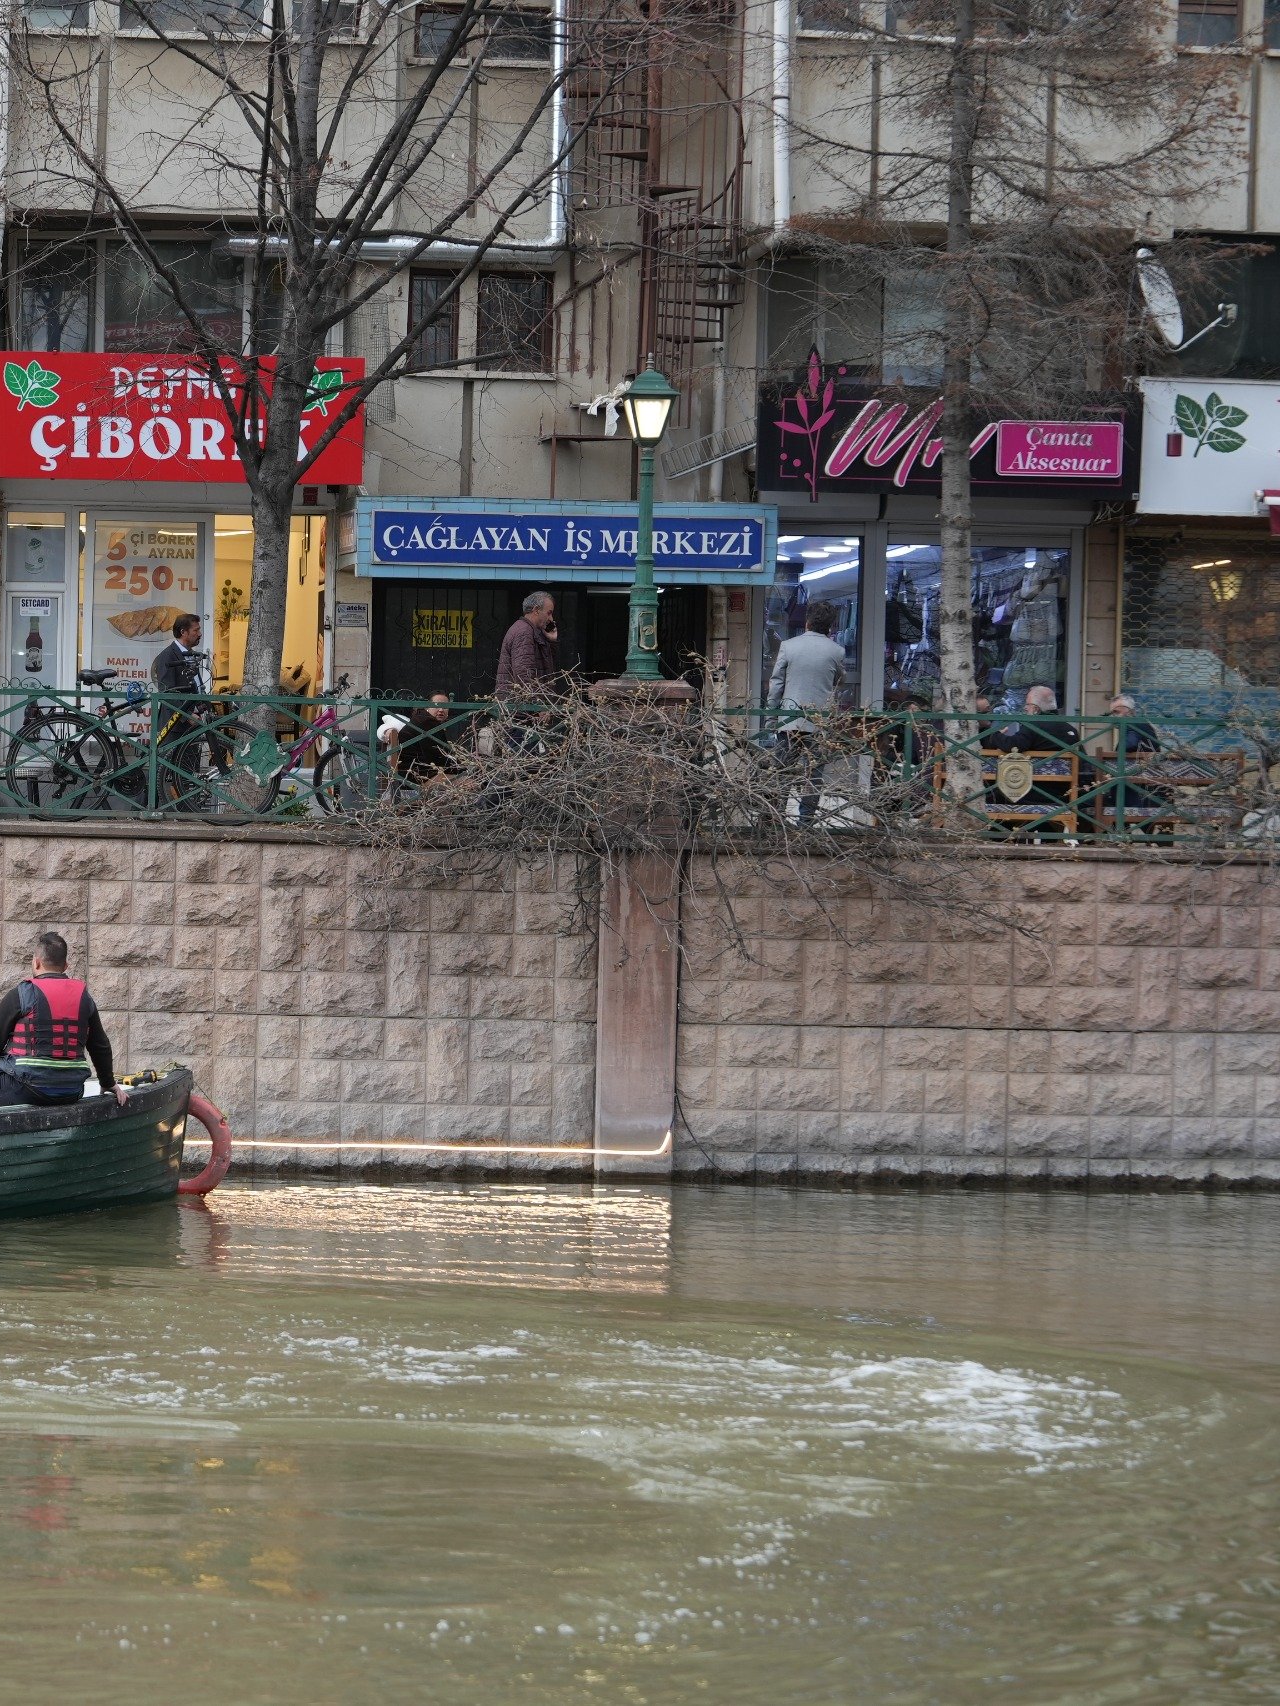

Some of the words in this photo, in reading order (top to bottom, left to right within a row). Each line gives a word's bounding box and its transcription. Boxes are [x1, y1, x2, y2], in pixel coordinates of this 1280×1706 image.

[1026, 426, 1093, 451] Çanta
[1007, 451, 1112, 473] Aksesuar
[382, 519, 552, 557] ÇAĞLAYAN
[564, 520, 593, 560] İŞ
[147, 547, 196, 560] AYRAN
[104, 564, 174, 597] 250
[177, 577, 199, 592] TL
[21, 598, 50, 608] SETCARD
[106, 657, 139, 666] MANTI
[116, 668, 148, 679] İTLERİ
